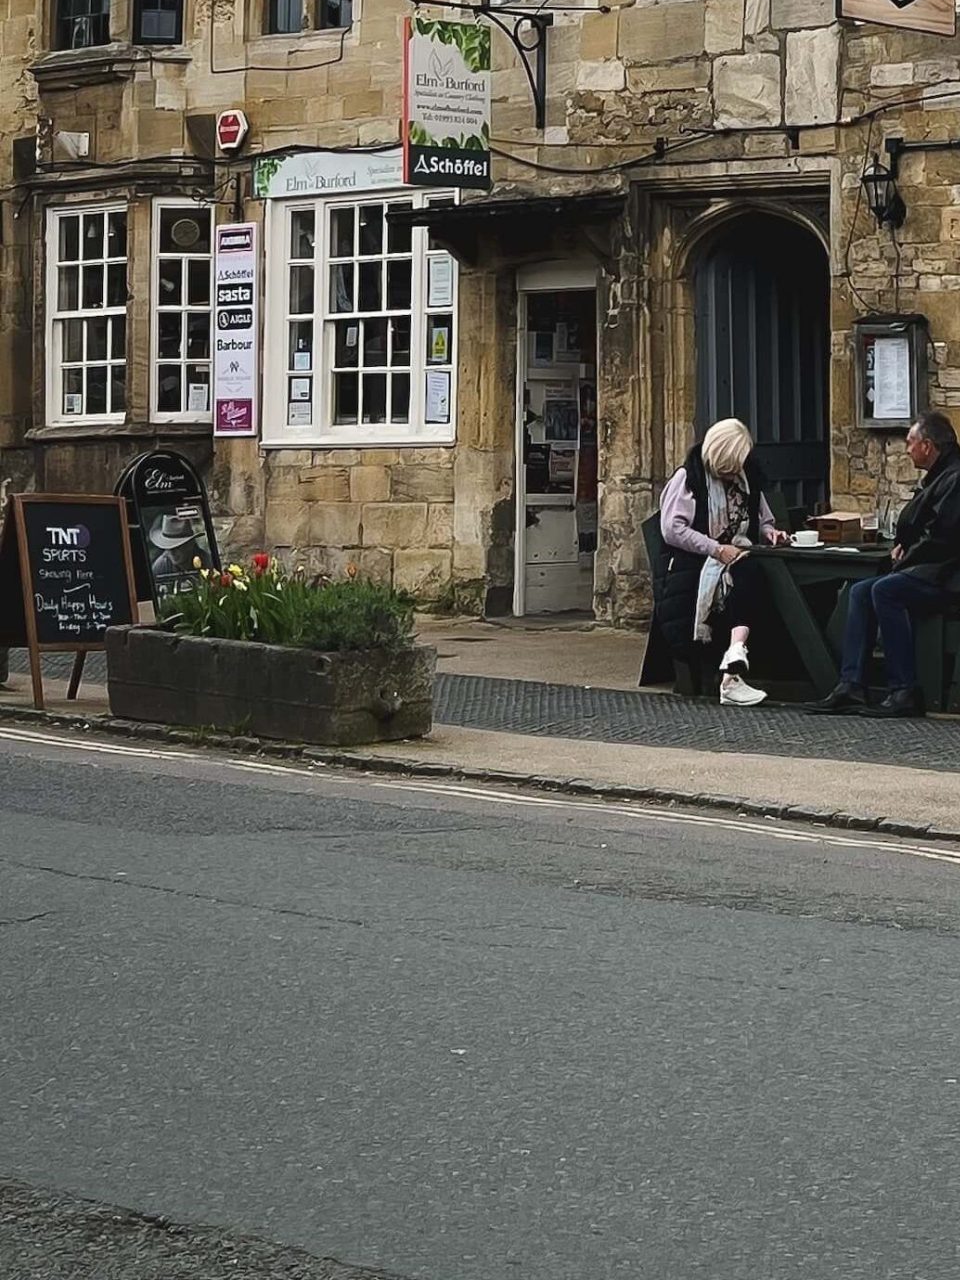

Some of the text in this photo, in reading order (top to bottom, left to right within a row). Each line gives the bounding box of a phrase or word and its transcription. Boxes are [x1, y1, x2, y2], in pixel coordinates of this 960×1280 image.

[416, 73, 438, 88] Elm
[446, 76, 486, 93] Burford
[430, 156, 488, 177] Schöffel
[286, 175, 308, 192] Elm
[315, 170, 357, 190] Burford
[218, 286, 251, 302] sasta
[229, 313, 251, 324] AIGLE
[217, 339, 253, 351] Barbour
[145, 469, 172, 489] Elm
[46, 527, 80, 546] TNT
[42, 548, 87, 562] SPORTS
[35, 593, 113, 617] Daily Happy Hours
